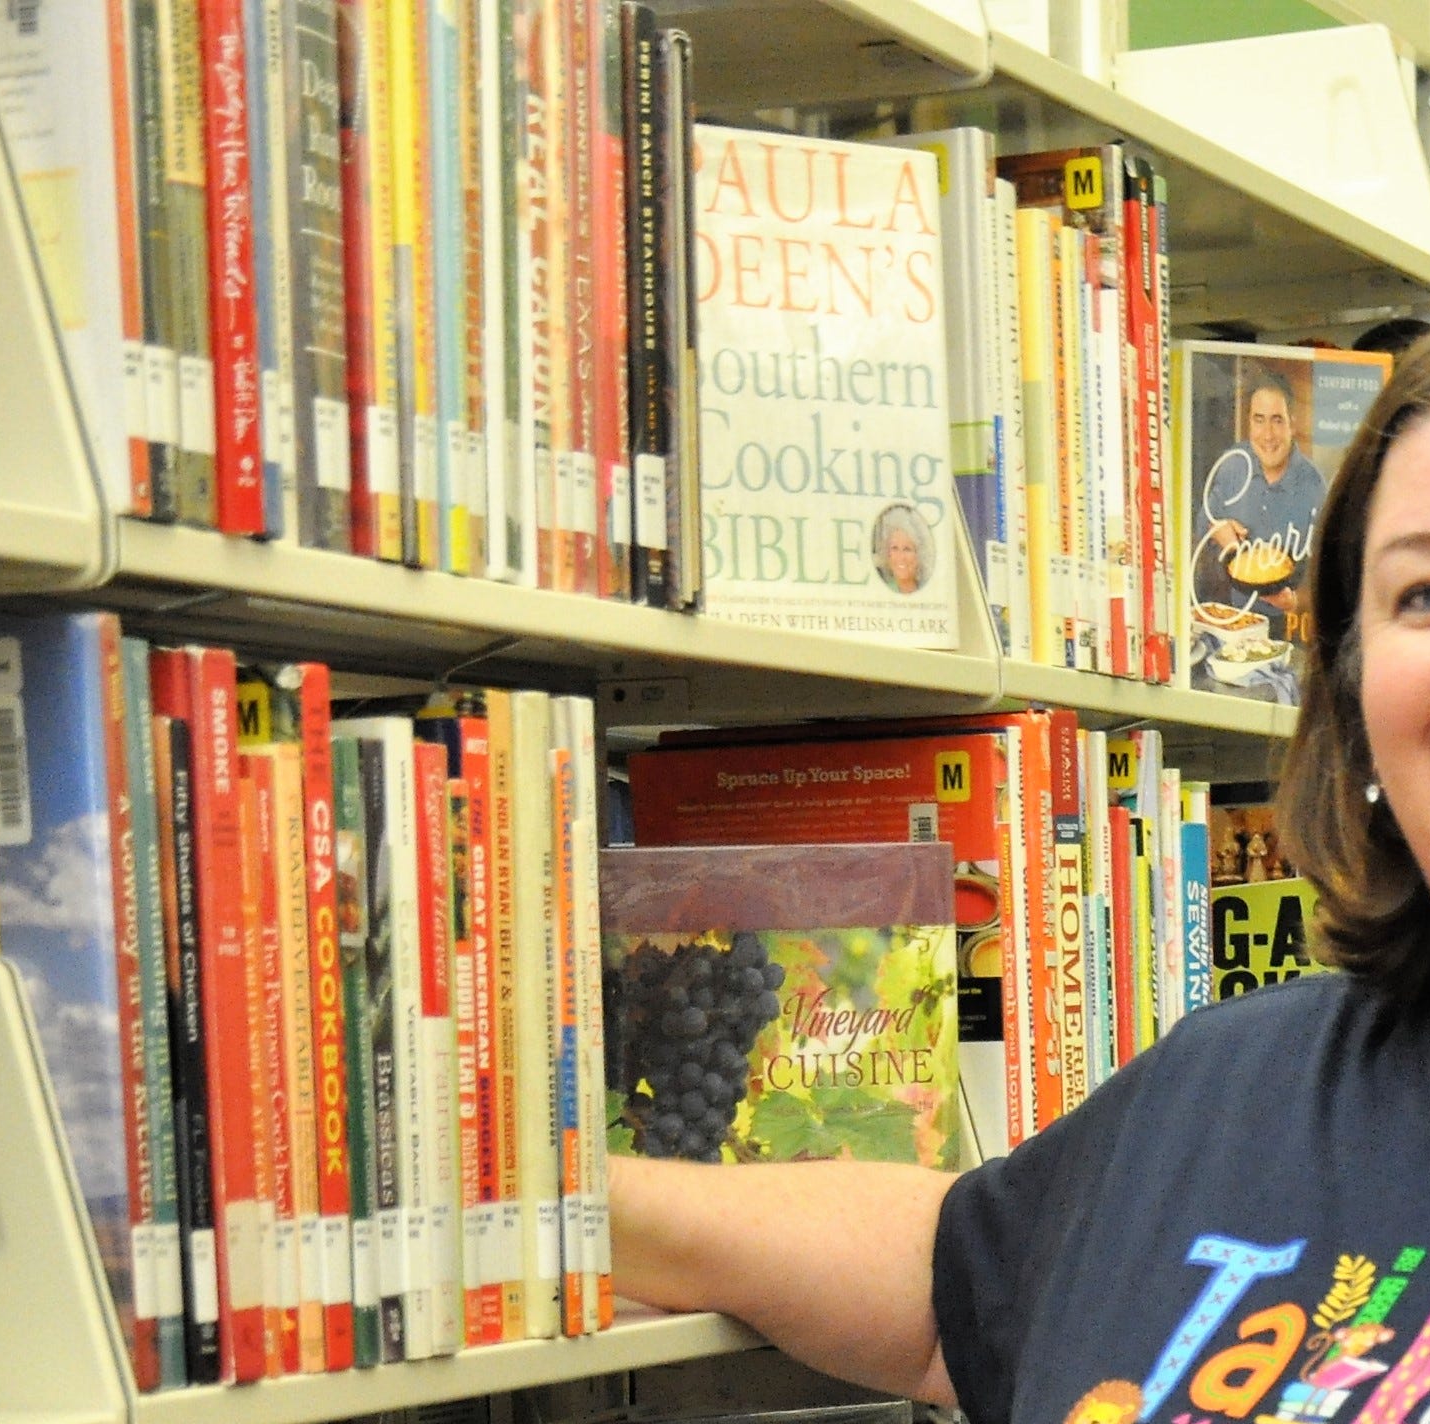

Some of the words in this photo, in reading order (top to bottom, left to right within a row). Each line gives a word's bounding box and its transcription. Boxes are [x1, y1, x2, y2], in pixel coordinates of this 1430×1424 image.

[525, 94, 549, 232] REAL
[1074, 172, 1094, 195] M
[576, 252, 593, 380] TEXAS
[641, 208, 655, 350] STEAKHOUSE
[691, 229, 937, 324] DEEN'S
[530, 256, 551, 422] CAJUN
[1009, 304, 1023, 439] BRYSON
[1158, 262, 1172, 431] UPHOLSTERY
[1072, 386, 1084, 467] Selling
[1146, 391, 1161, 490] HOME
[1099, 490, 1107, 562] HOME
[785, 614, 829, 630] WITH
[834, 617, 894, 632] MELISSA
[898, 618, 949, 634] CLARK
[211, 690, 231, 795] SMOKE
[238, 700, 260, 735] M
[174, 770, 191, 829] Fifty
[496, 752, 508, 790] THE
[716, 769, 780, 791] Spruce
[782, 766, 808, 789] Up
[807, 765, 849, 783] Your
[852, 763, 912, 785] Space!
[942, 763, 964, 791] M
[1110, 752, 1130, 777] M
[311, 799, 335, 893] CSA
[425, 765, 447, 888] Vegetable
[497, 796, 511, 862] NOLAN
[177, 832, 194, 913] Shades
[473, 845, 488, 928] GREAT
[498, 864, 512, 917] RYAN
[1003, 833, 1012, 915] Handyman
[181, 918, 198, 946] of
[432, 895, 451, 988] Harvest
[499, 924, 513, 980] BEEF
[1059, 854, 1085, 1039] HOME
[1198, 883, 1211, 967] Simply
[183, 950, 201, 1043] Chicken
[476, 934, 492, 1069] AMERICAN
[587, 899, 605, 1048] CHICKEN
[1004, 926, 1018, 1016] refresh
[116, 823, 143, 957] Cowboy
[132, 1083, 155, 1220] Kitchen
[288, 948, 313, 1100] VEGETABLE
[315, 904, 343, 1176] COOKBOOK
[782, 983, 927, 1055] Vineyard
[1008, 1021, 1018, 1056] your
[406, 1004, 421, 1126] VEGETABLE
[767, 1048, 935, 1091] CUISINE
[1010, 1063, 1022, 1137] home
[377, 1052, 397, 1206] Brassicas
[479, 1076, 493, 1169] BURGER
